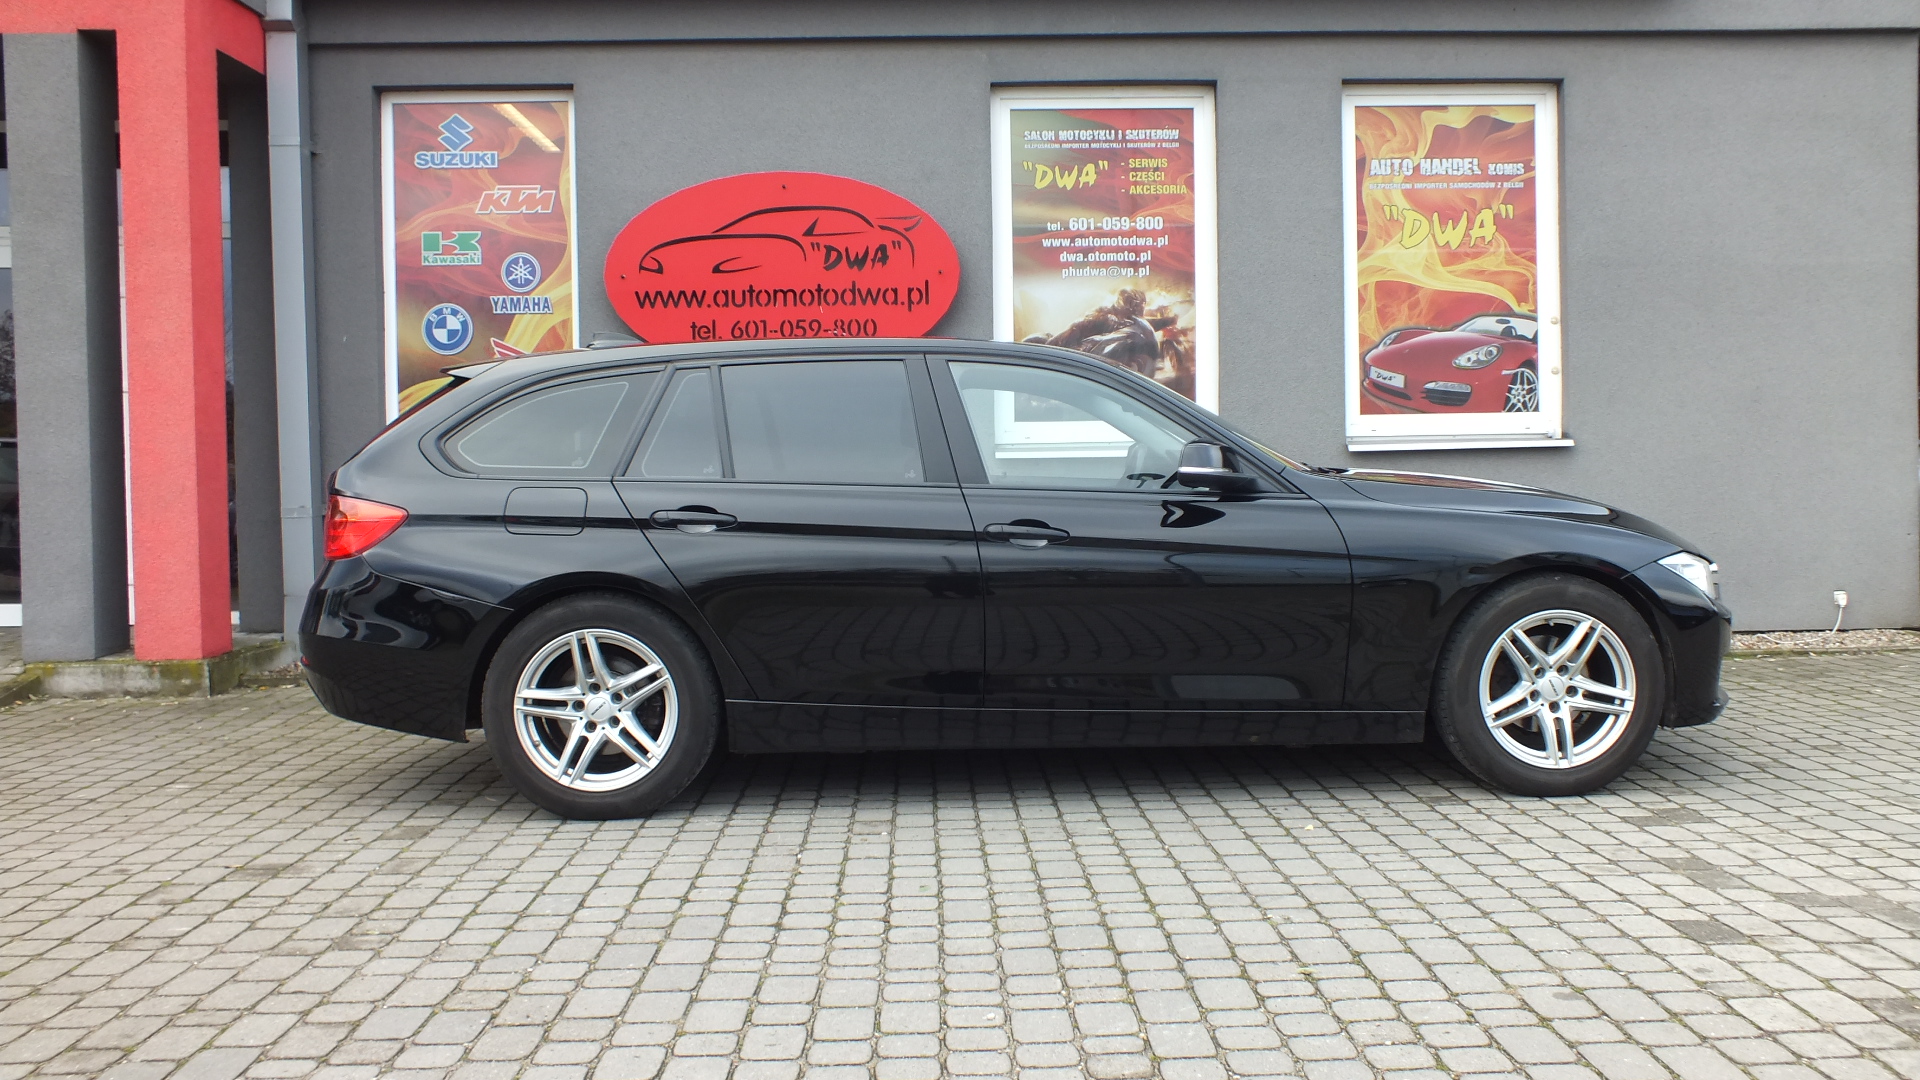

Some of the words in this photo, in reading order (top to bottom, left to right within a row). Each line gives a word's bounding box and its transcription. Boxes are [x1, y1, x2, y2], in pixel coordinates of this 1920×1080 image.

[1024, 130, 1055, 141] SALON
[1058, 129, 1115, 141] MOTOCYKLI
[1125, 125, 1180, 140] SKUTERÓW
[415, 152, 497, 167] SUZUKI
[1128, 158, 1168, 168] SERWIS
[1369, 158, 1414, 176] AUTO
[1420, 158, 1482, 176] HANDEL
[1488, 163, 1525, 176] KOMIS
[1129, 169, 1165, 183] CZĘŚCI
[1129, 185, 1188, 195] AKCESORIA
[475, 185, 556, 214] KTM
[1047, 221, 1065, 231] tel.
[1068, 217, 1164, 231] 601-059-800
[1042, 235, 1169, 248] www.automotodwa.pl
[423, 253, 481, 265] Kawasaki
[1060, 251, 1151, 263] dwa.otomoto.pl
[1062, 266, 1150, 279] phudwa@vp.pl
[635, 280, 930, 312] www.automotodwa.pl
[491, 296, 553, 314] YAMAHA
[428, 306, 467, 323] BMW
[690, 319, 723, 341] tel.
[730, 318, 878, 339] 601-059-800
